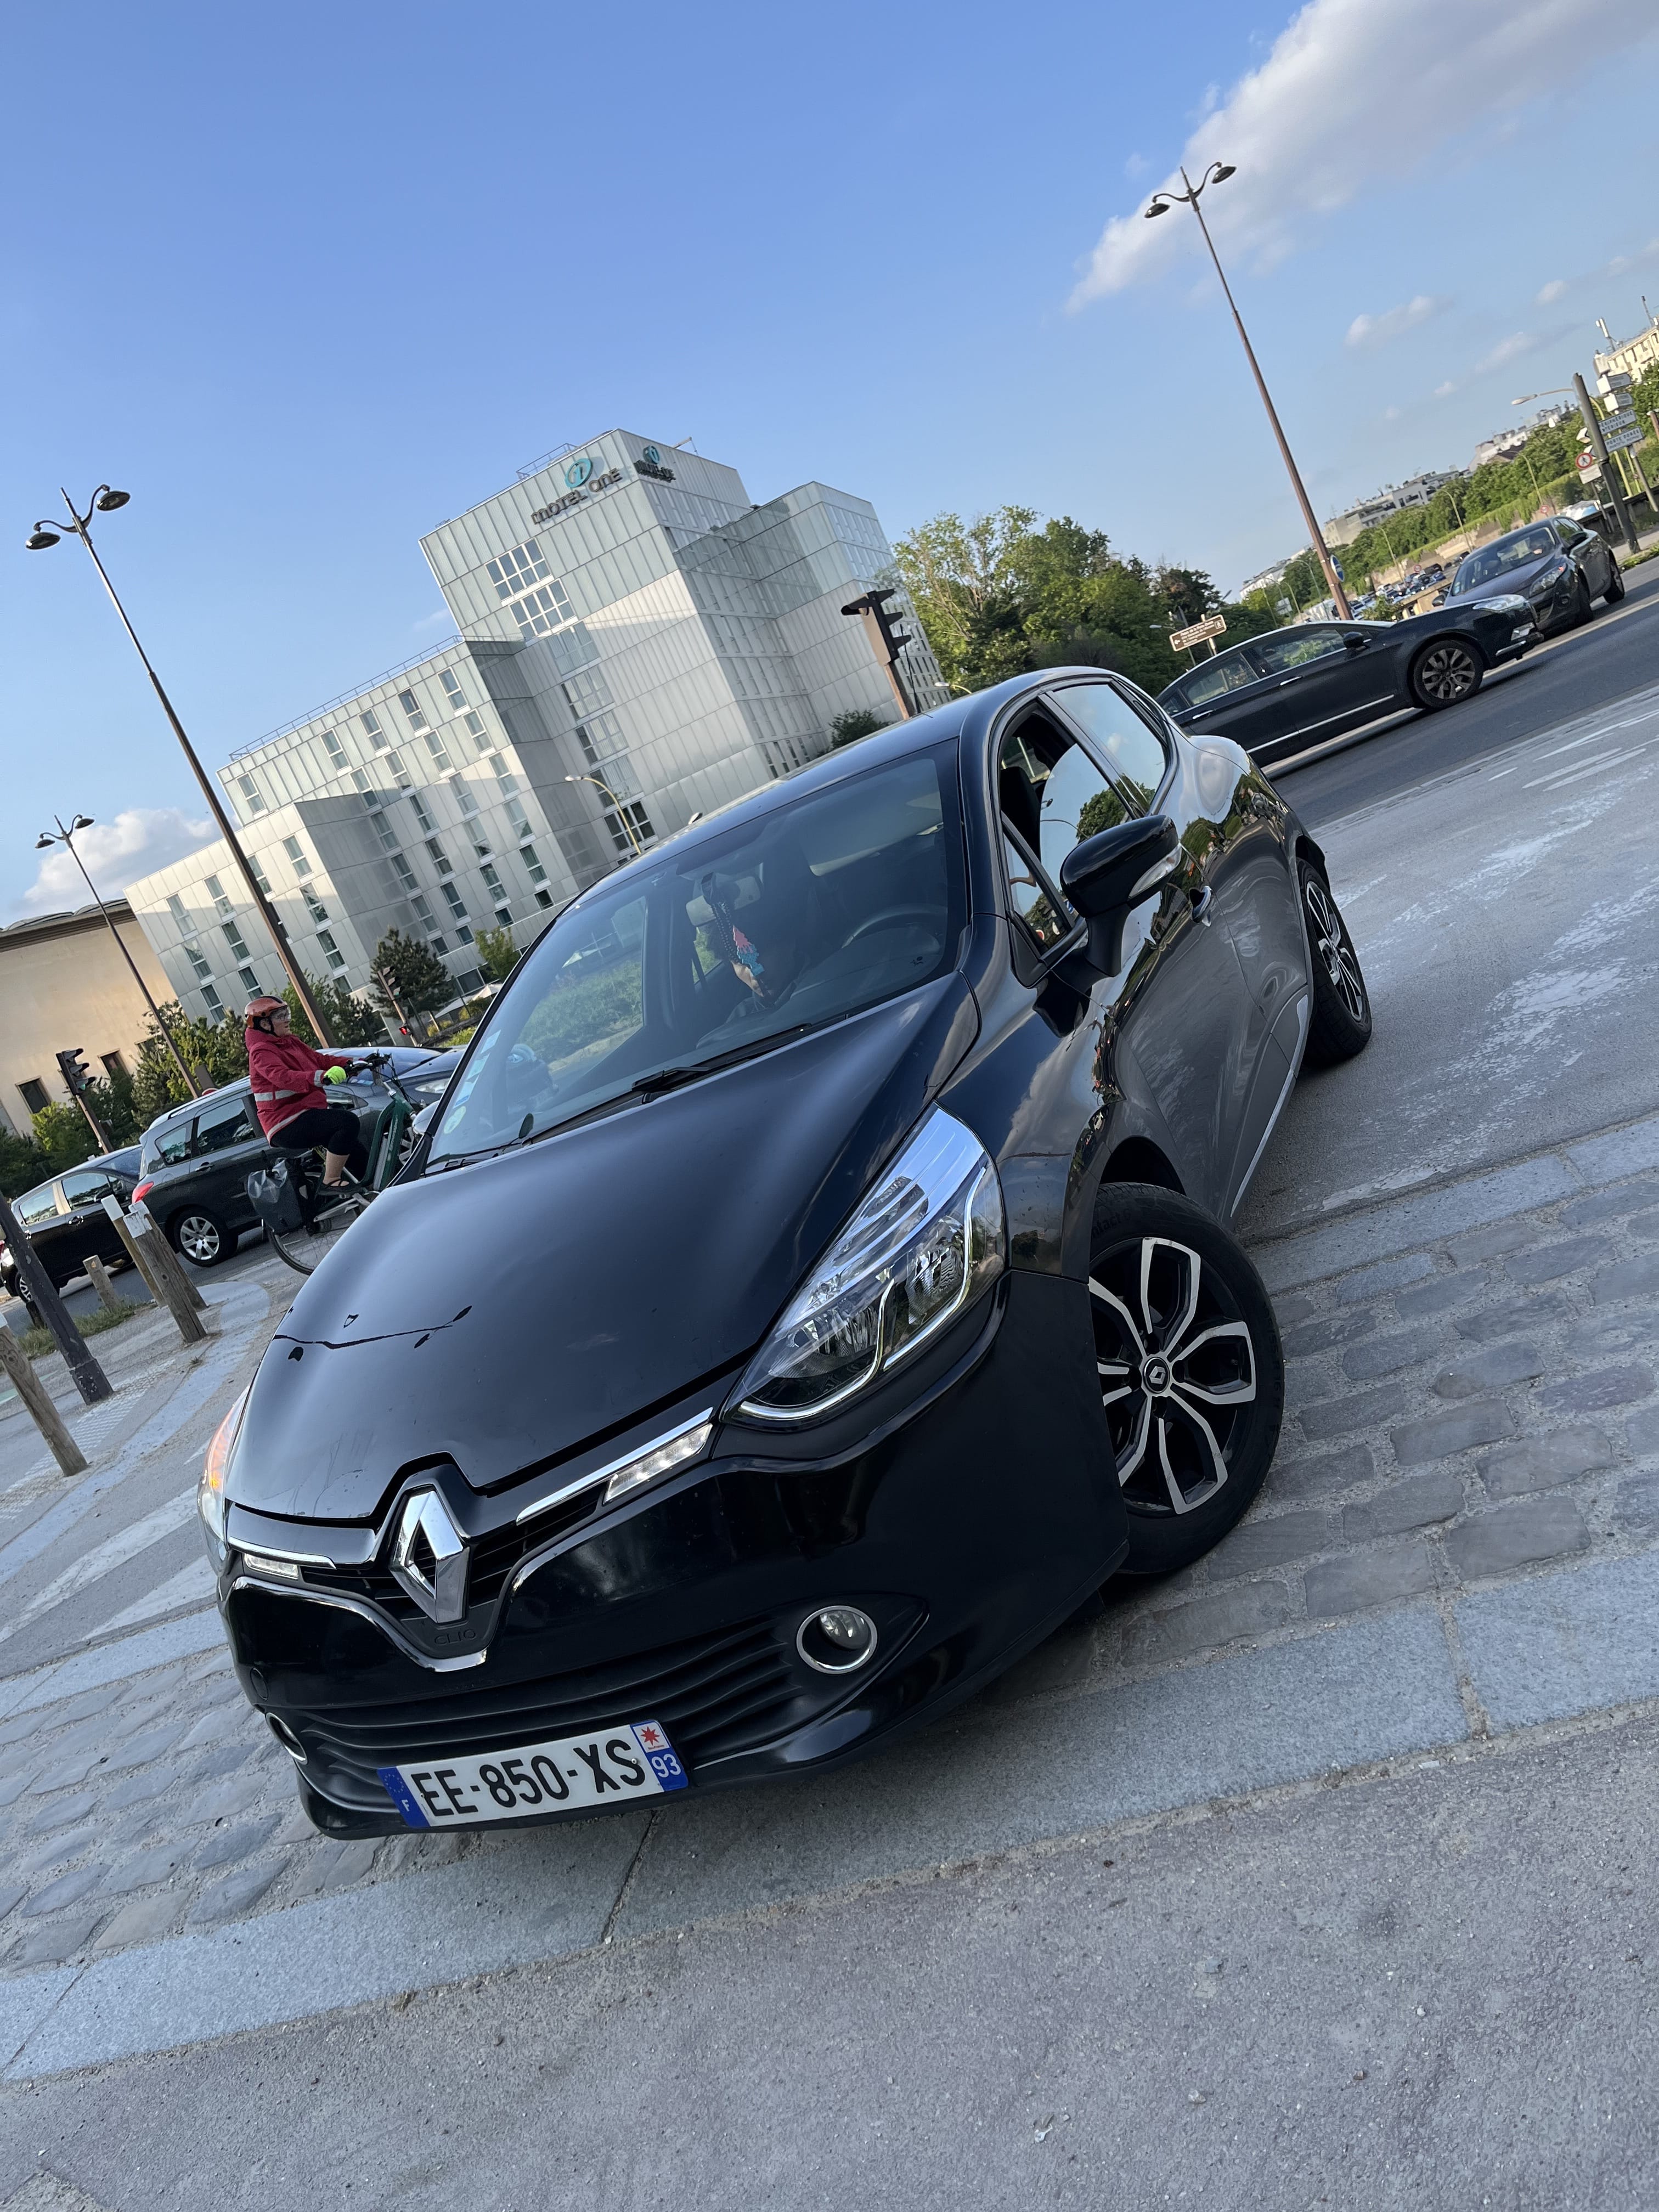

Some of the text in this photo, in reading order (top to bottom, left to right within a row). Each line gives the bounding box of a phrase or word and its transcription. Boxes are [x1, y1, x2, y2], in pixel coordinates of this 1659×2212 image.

[434, 1628, 476, 1645] CLIO
[401, 1739, 646, 1817] F EE-850-XS
[651, 1753, 681, 1778] 93
